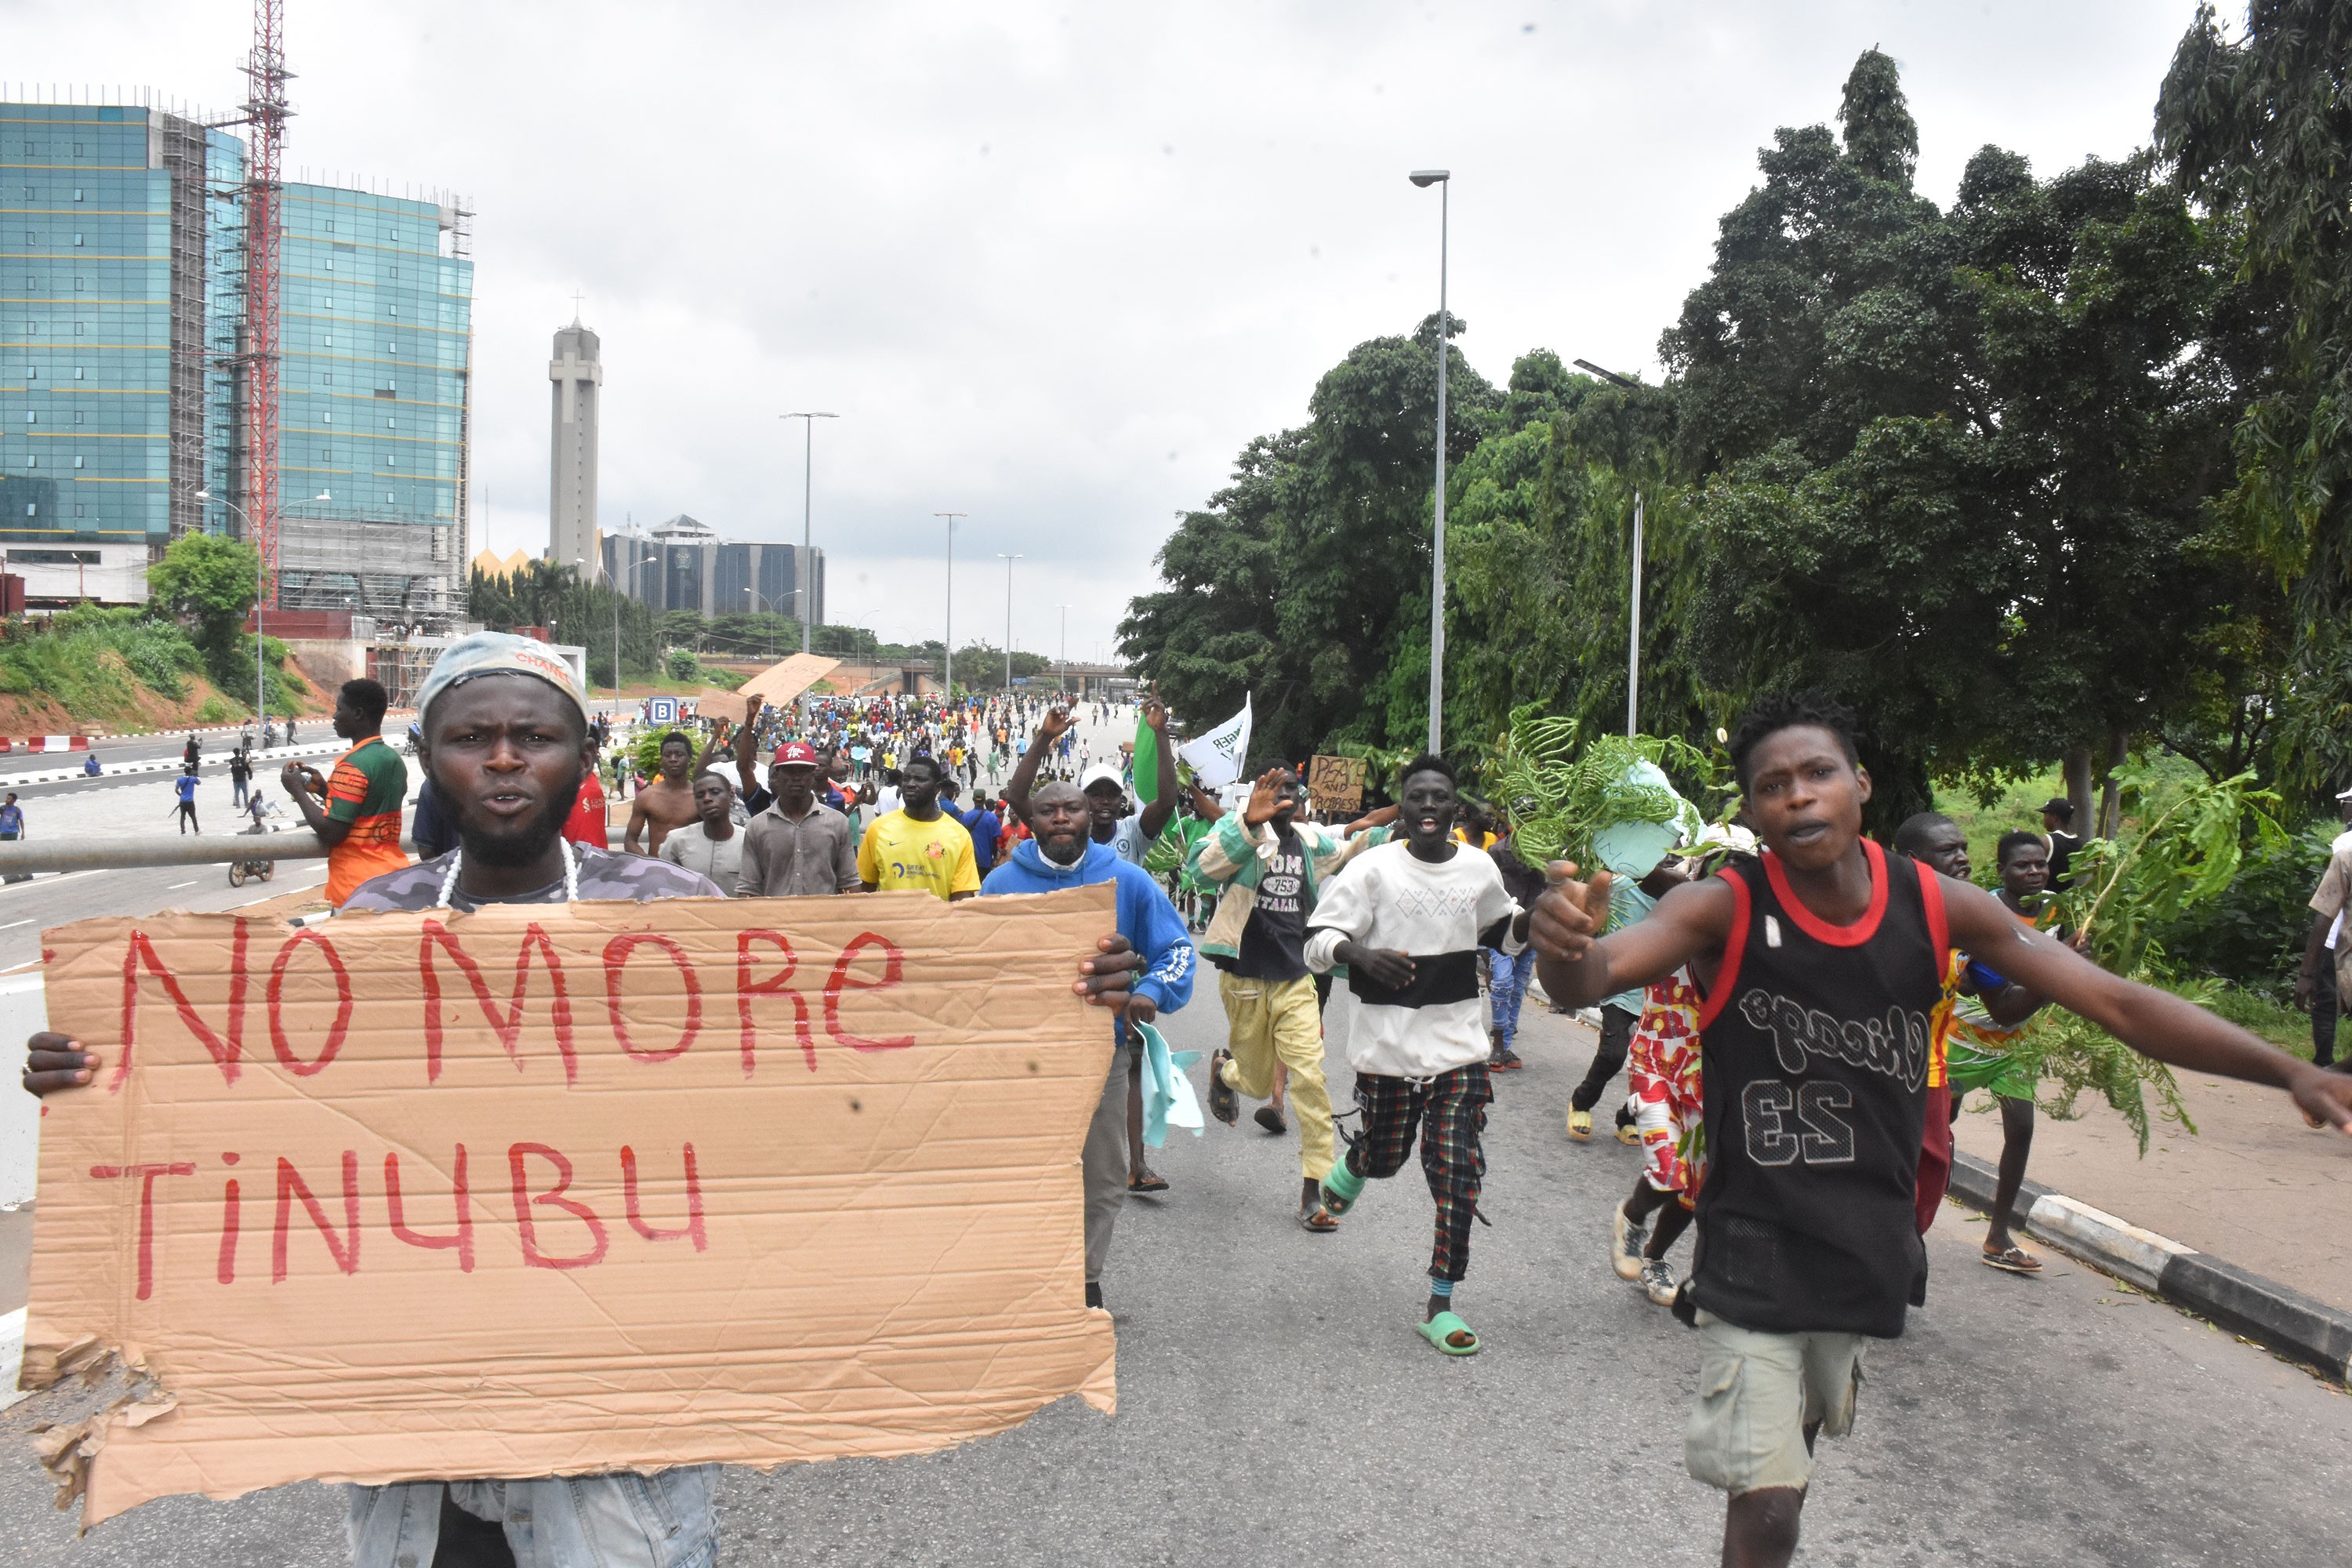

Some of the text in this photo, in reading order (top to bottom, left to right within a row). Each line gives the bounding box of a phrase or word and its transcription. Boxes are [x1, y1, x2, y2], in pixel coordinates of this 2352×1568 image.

[516, 653, 572, 687] CHANEL
[659, 705, 667, 717] B
[1323, 784, 1348, 793] AND
[1275, 879, 1294, 892] 753
[1254, 895, 1299, 912] ITALIA
[109, 917, 354, 1092] NO
